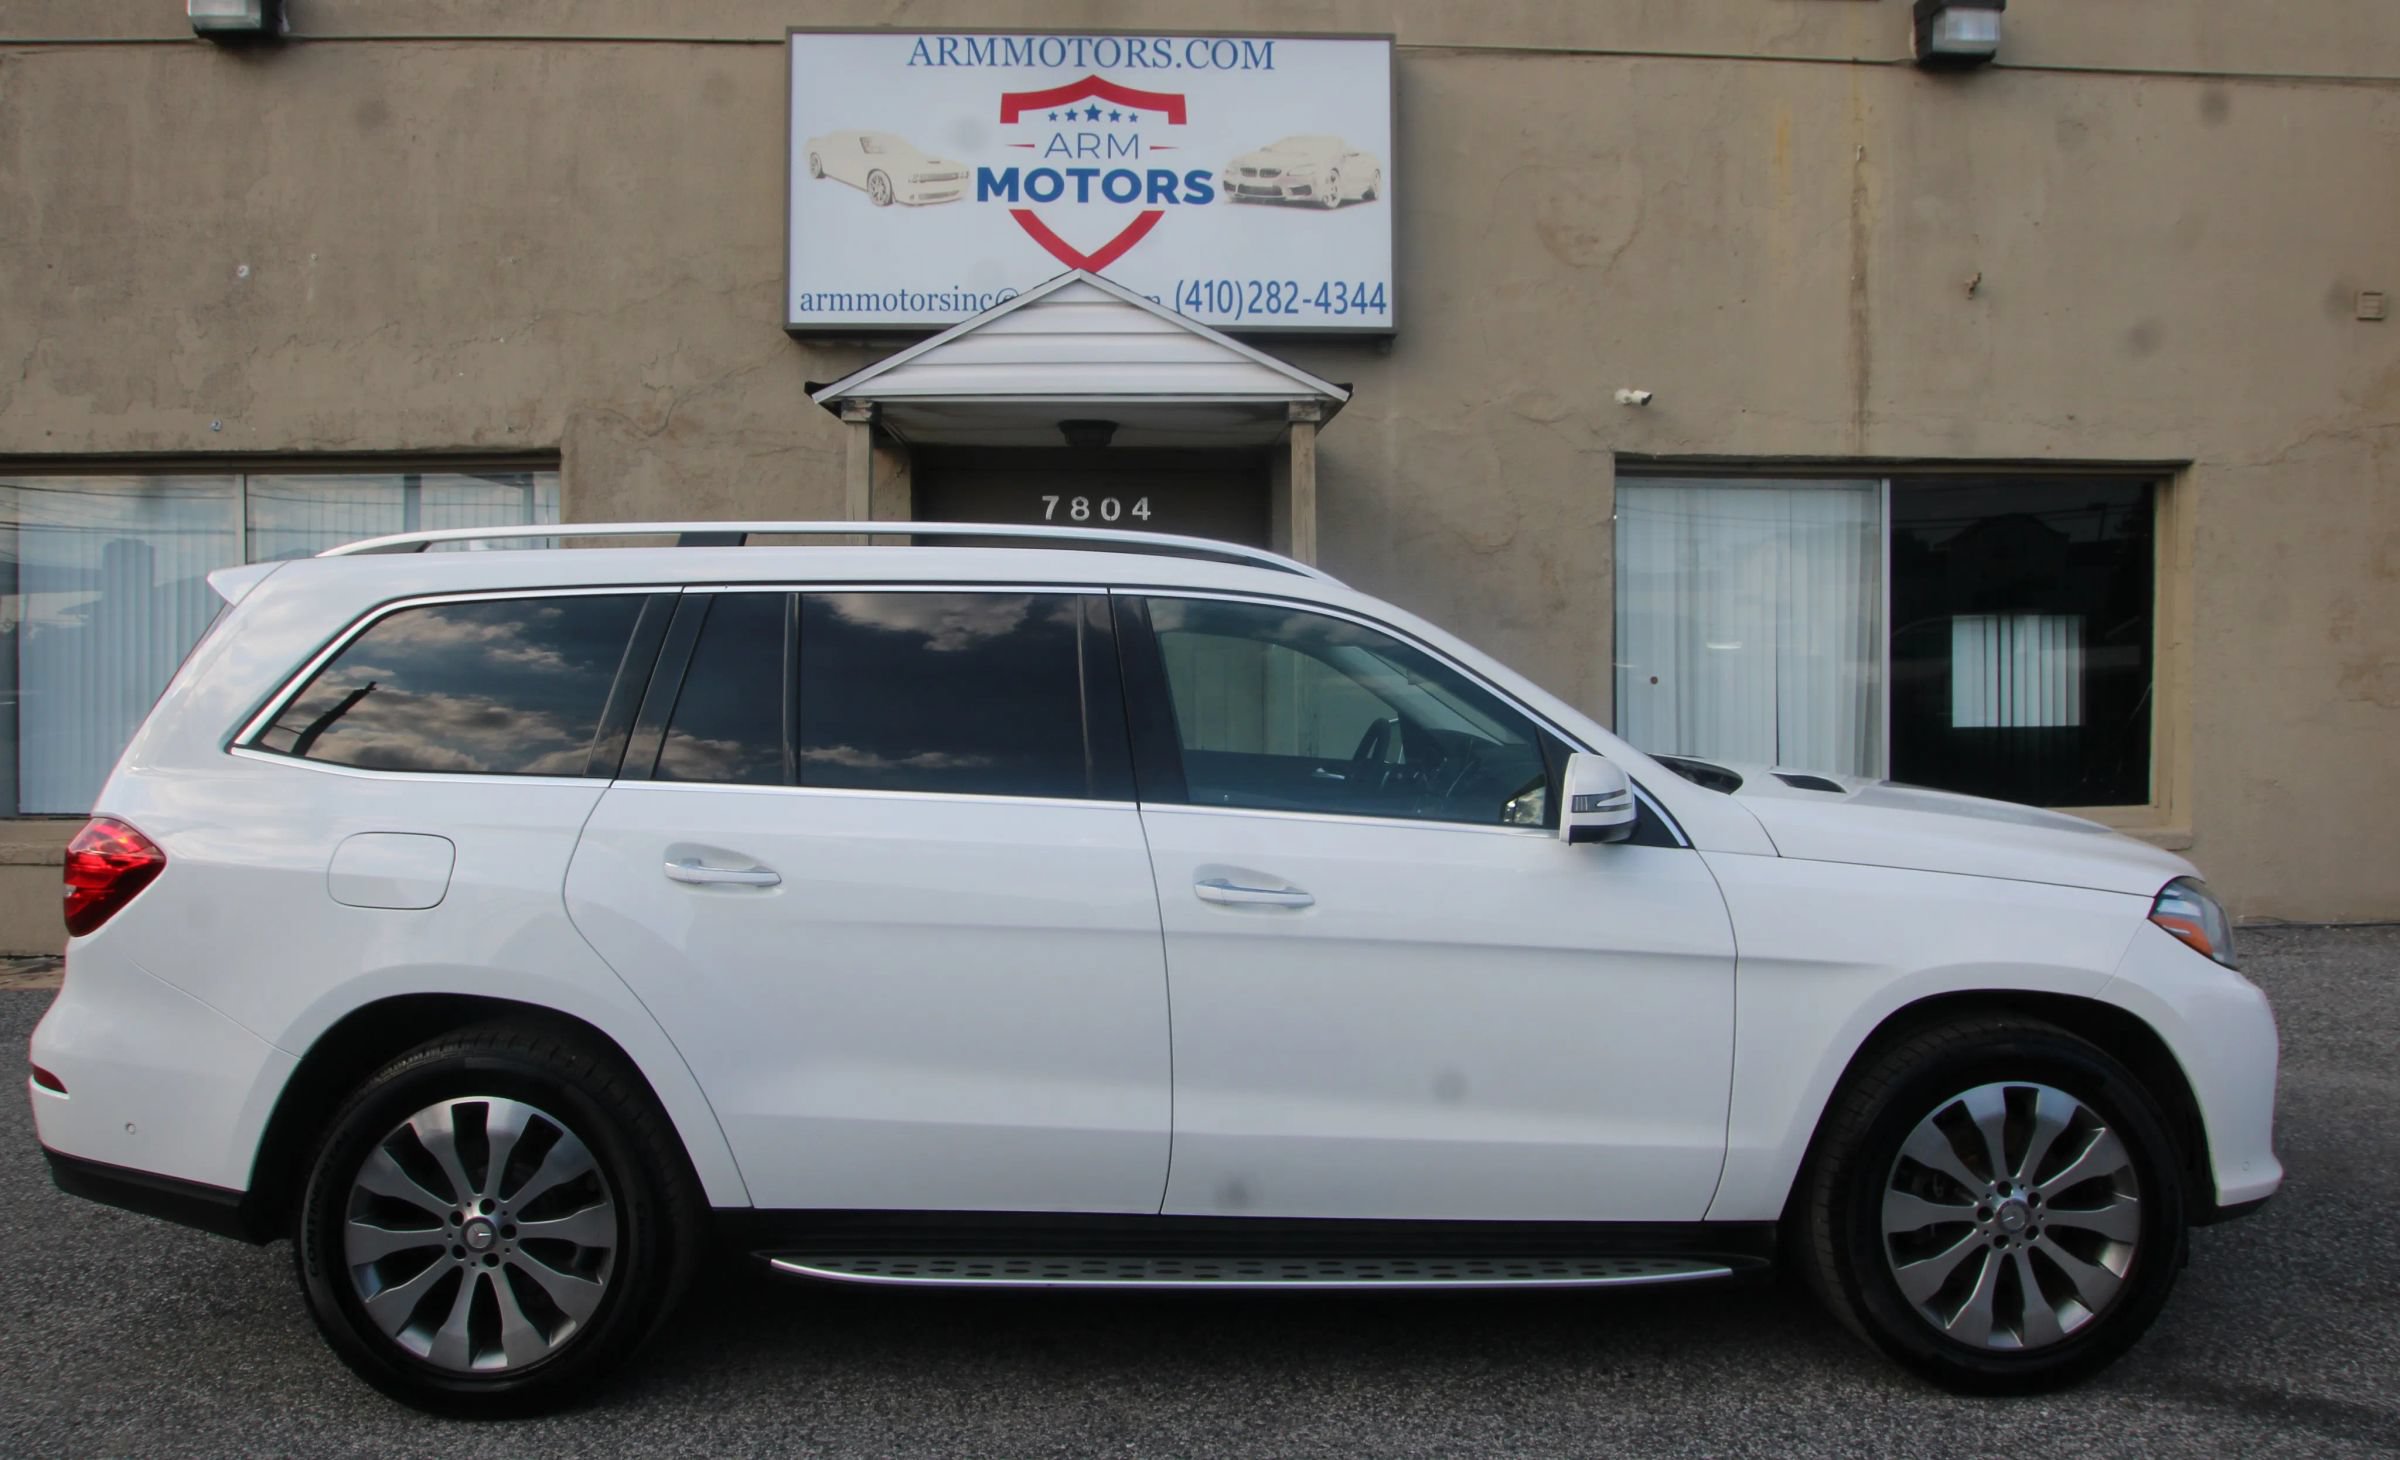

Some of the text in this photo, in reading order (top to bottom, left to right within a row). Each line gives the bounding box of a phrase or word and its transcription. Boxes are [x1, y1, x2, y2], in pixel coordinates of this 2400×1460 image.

[906, 36, 1275, 70] ARMMOTORS.COM
[1044, 132, 1139, 160] ARM
[976, 167, 1215, 205] MOTORS
[1175, 279, 1387, 320] (410)282-4344
[1042, 495, 1151, 521] 7804
